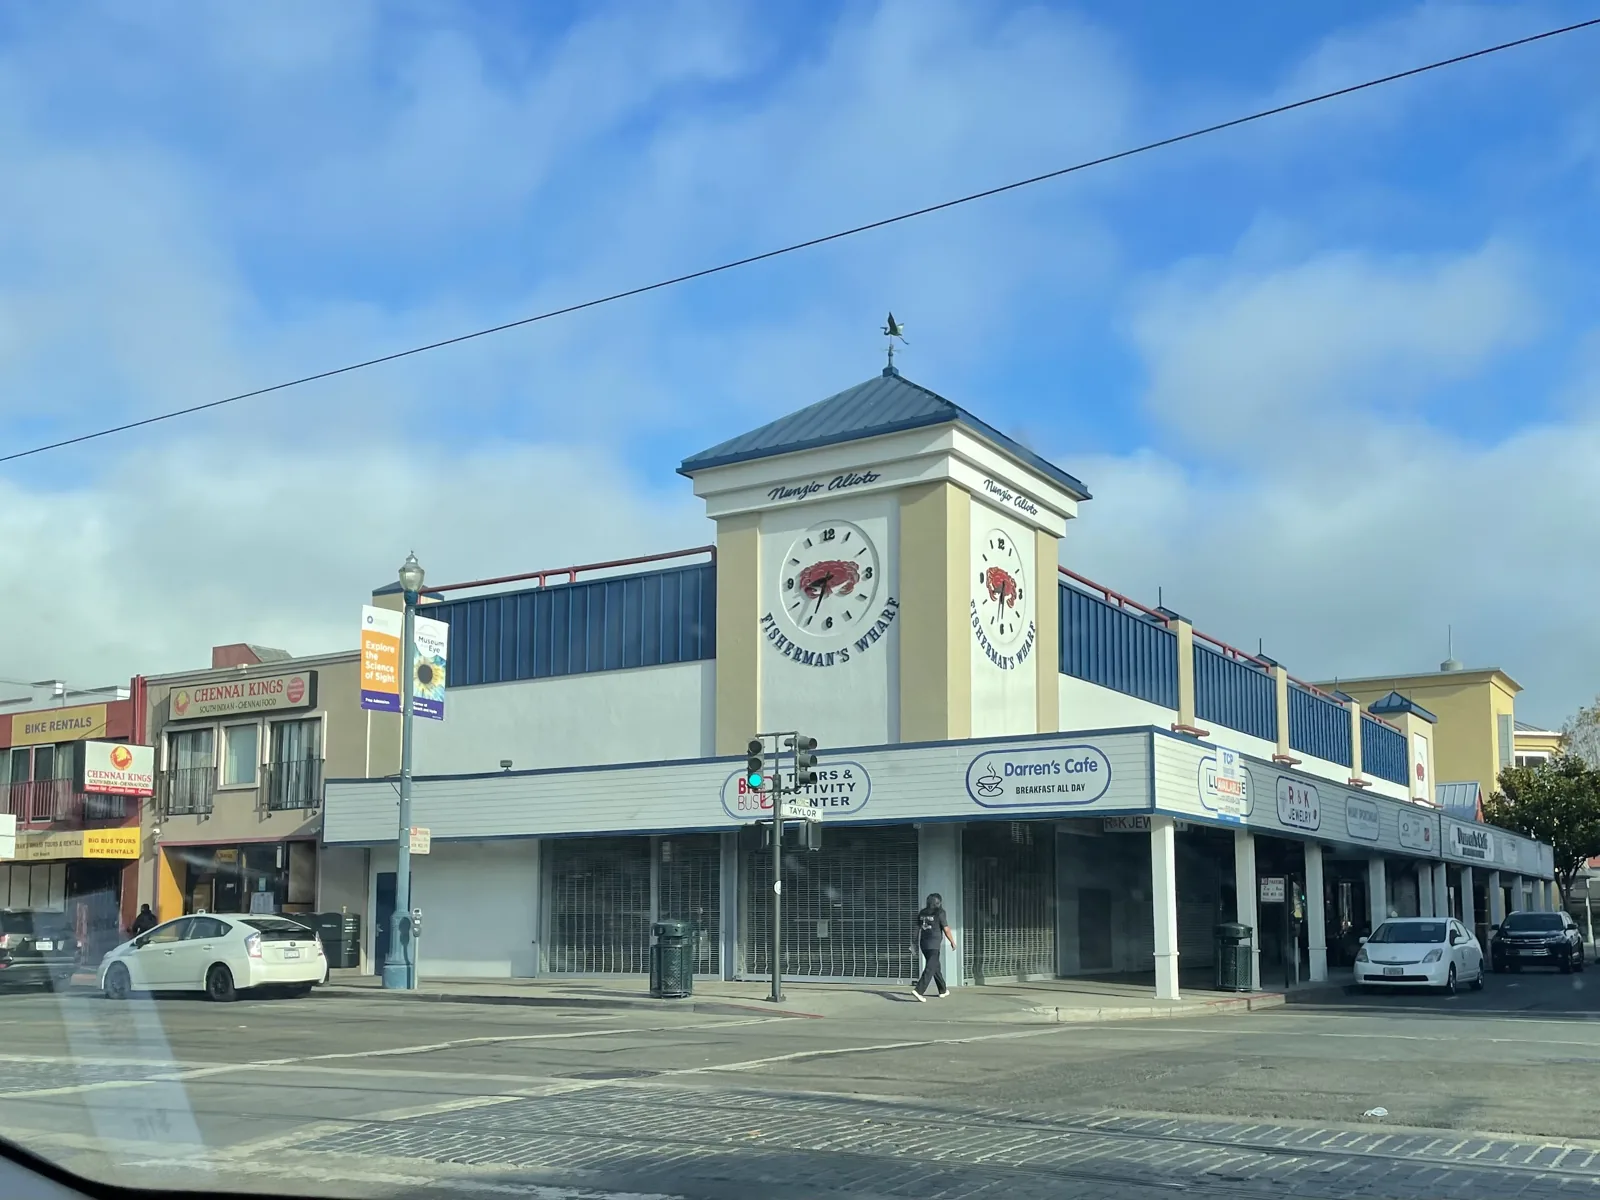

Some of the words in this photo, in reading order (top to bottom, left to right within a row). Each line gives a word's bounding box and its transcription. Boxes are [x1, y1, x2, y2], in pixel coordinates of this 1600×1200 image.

[768, 480, 824, 500] Nunzio
[828, 471, 881, 490] Alioto
[984, 479, 1013, 502] Nunzio
[1014, 496, 1038, 515] Alioto
[823, 528, 835, 541] 12
[997, 538, 1005, 550] 12
[787, 578, 794, 589] 9
[865, 566, 873, 579] 3
[825, 616, 833, 629] 6
[760, 612, 850, 667] FISHERMAN'S
[854, 597, 900, 652] WHARF
[970, 599, 1014, 670] FISHERMAN'S
[1016, 620, 1036, 664] WHARF
[365, 641, 395, 654] Explore
[418, 636, 445, 647] Museum
[366, 651, 378, 660] the
[428, 645, 441, 653] Eye
[365, 661, 394, 673] Science
[365, 671, 373, 679] of
[376, 673, 395, 683] Sight
[194, 684, 244, 703] CHENNAI
[248, 679, 283, 696] KINGS
[261, 698, 277, 707] FOOD
[25, 722, 47, 734] BIKE
[49, 717, 92, 731] RENTALS
[1004, 760, 1060, 777] Darren's
[1065, 757, 1098, 774] Cafe
[87, 770, 125, 780] CHENNAI
[128, 773, 152, 782] KINGS
[787, 771, 838, 782] TRS
[843, 769, 853, 779] &
[1015, 785, 1055, 794] BREAKFAST
[1057, 784, 1069, 792] ALL
[1071, 783, 1086, 792] DAY
[738, 794, 759, 810] BUS
[788, 796, 850, 808] CNTER
[1288, 785, 1294, 805] R
[1303, 790, 1310, 808] K
[789, 806, 817, 817] TAYLOR
[1288, 808, 1312, 824] JEWELRY
